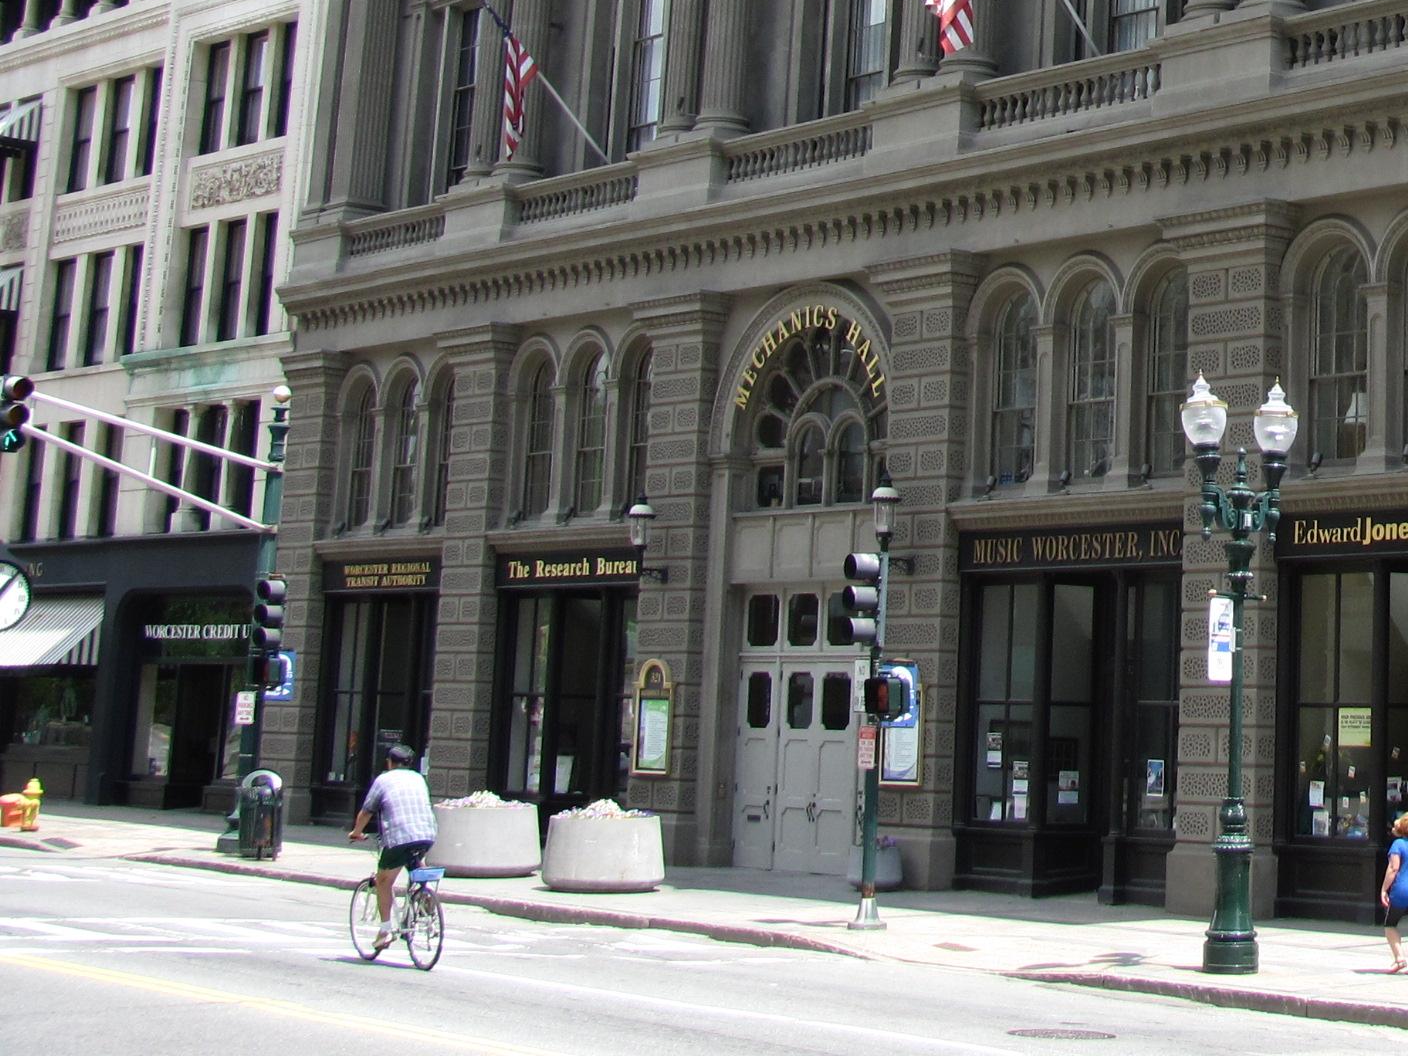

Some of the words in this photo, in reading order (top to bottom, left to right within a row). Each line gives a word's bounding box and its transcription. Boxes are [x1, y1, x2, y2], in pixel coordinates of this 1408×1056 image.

[735, 304, 838, 411] MECHANICS
[846, 319, 886, 398] HALL
[973, 536, 1023, 564] MUSIC
[1032, 531, 1143, 561] WORCESTER,
[344, 564, 389, 575] WORCESTER
[391, 561, 432, 573] REGIONAL
[508, 560, 530, 578] The
[535, 557, 590, 578] Research
[346, 576, 380, 587] TRANSIT
[382, 574, 427, 586] AUTHORITY
[144, 624, 201, 639] WORCESTER
[202, 624, 241, 639] CREDIT
